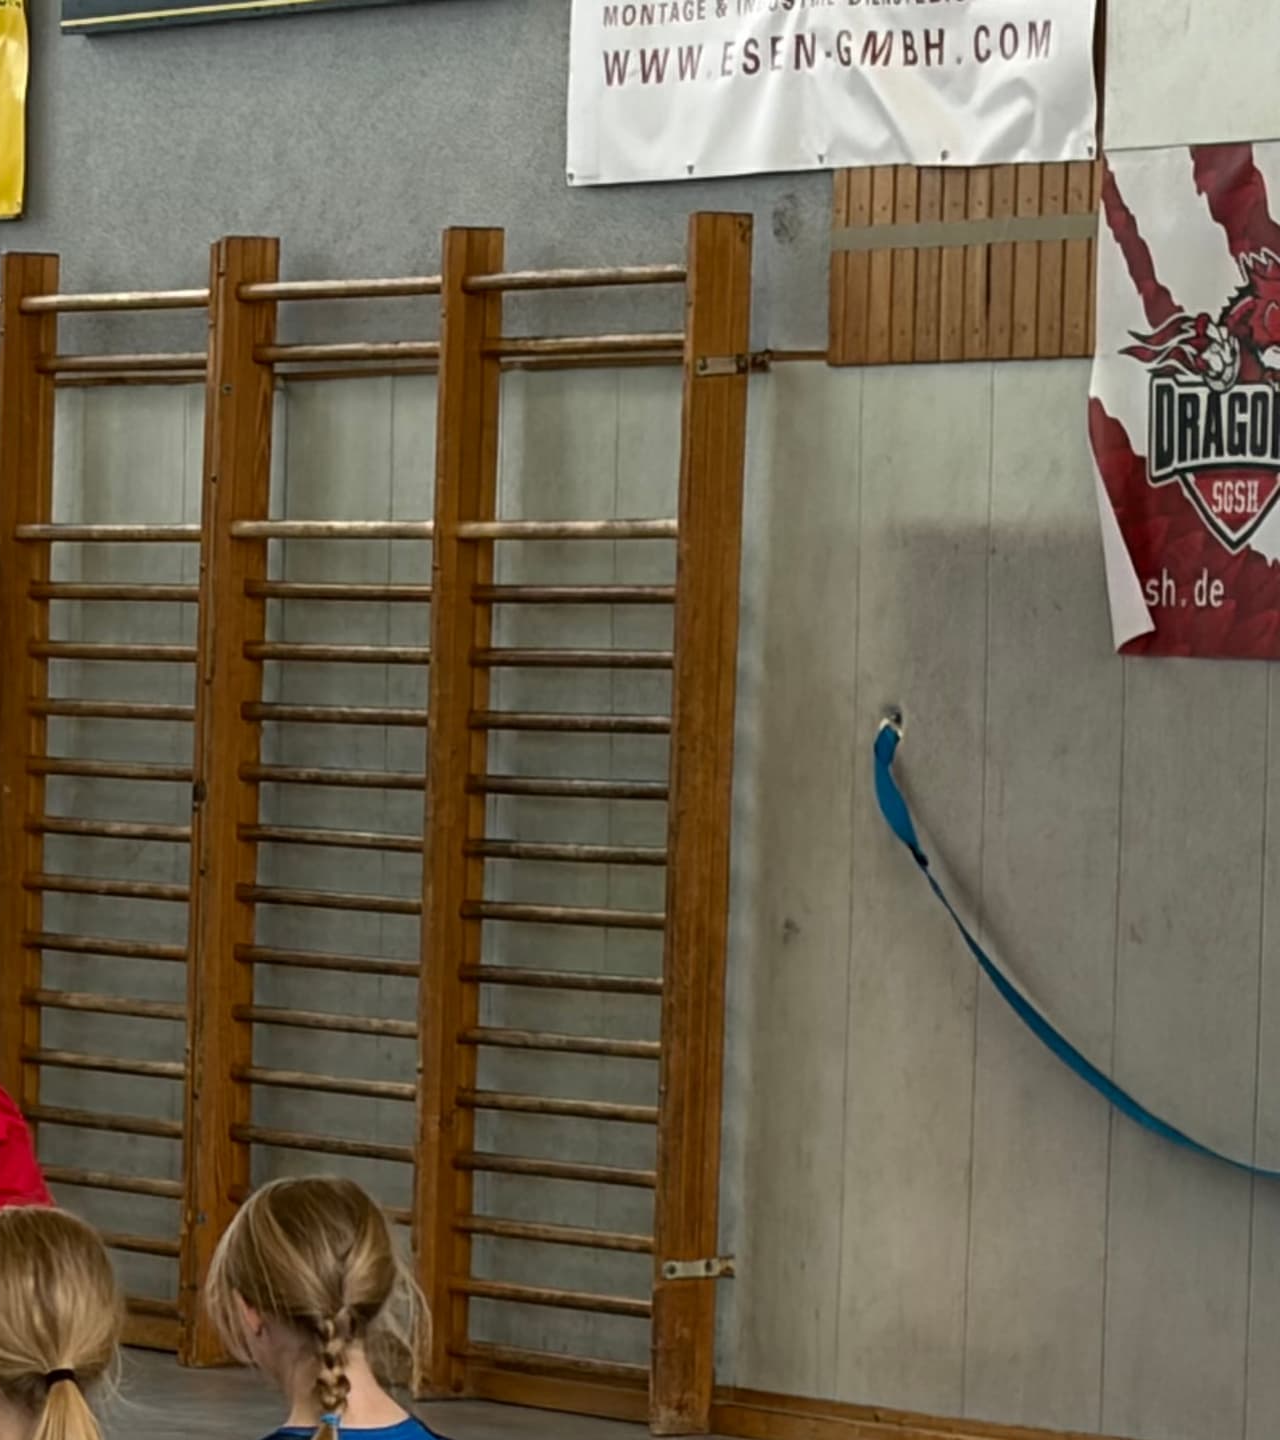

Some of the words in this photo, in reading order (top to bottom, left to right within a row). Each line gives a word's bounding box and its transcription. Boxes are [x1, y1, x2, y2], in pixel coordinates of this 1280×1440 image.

[602, 2, 707, 28] MONTAGE
[602, 20, 1053, 87] WWW.ESEN-GMBH.COM
[1211, 480, 1260, 514] SGSH
